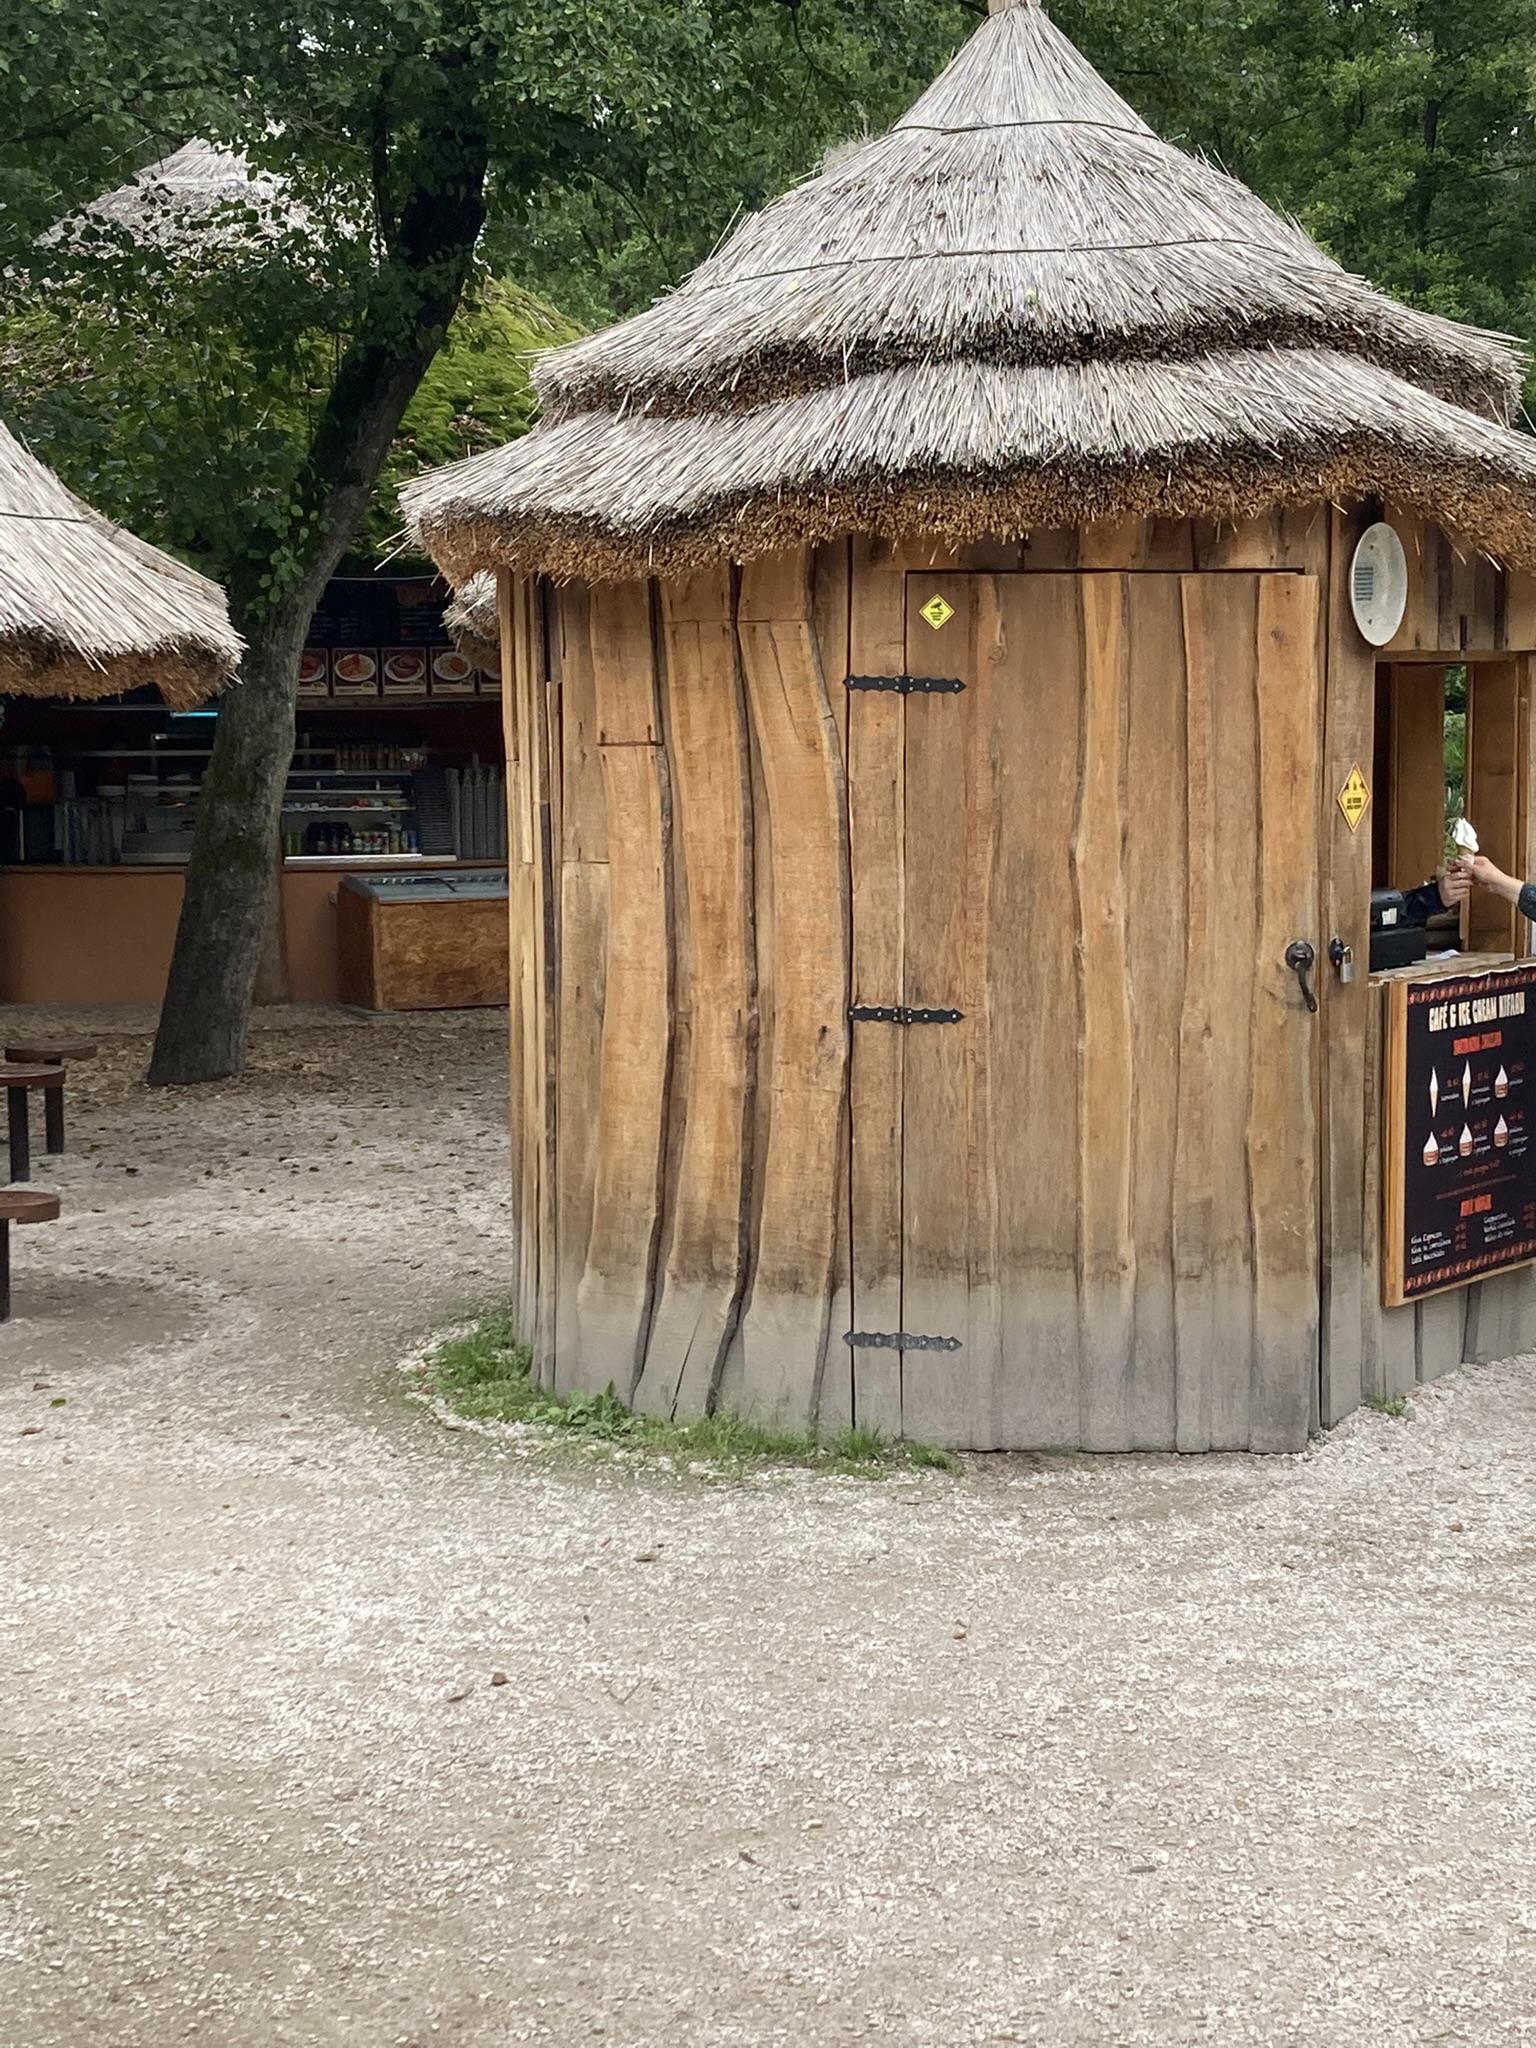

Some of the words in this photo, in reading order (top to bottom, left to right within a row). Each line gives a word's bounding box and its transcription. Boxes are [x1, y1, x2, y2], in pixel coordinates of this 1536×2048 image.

[1429, 1001, 1448, 1032] CAFÉ
[1458, 1001, 1471, 1026] ICE
[1472, 996, 1497, 1024] CREAM
